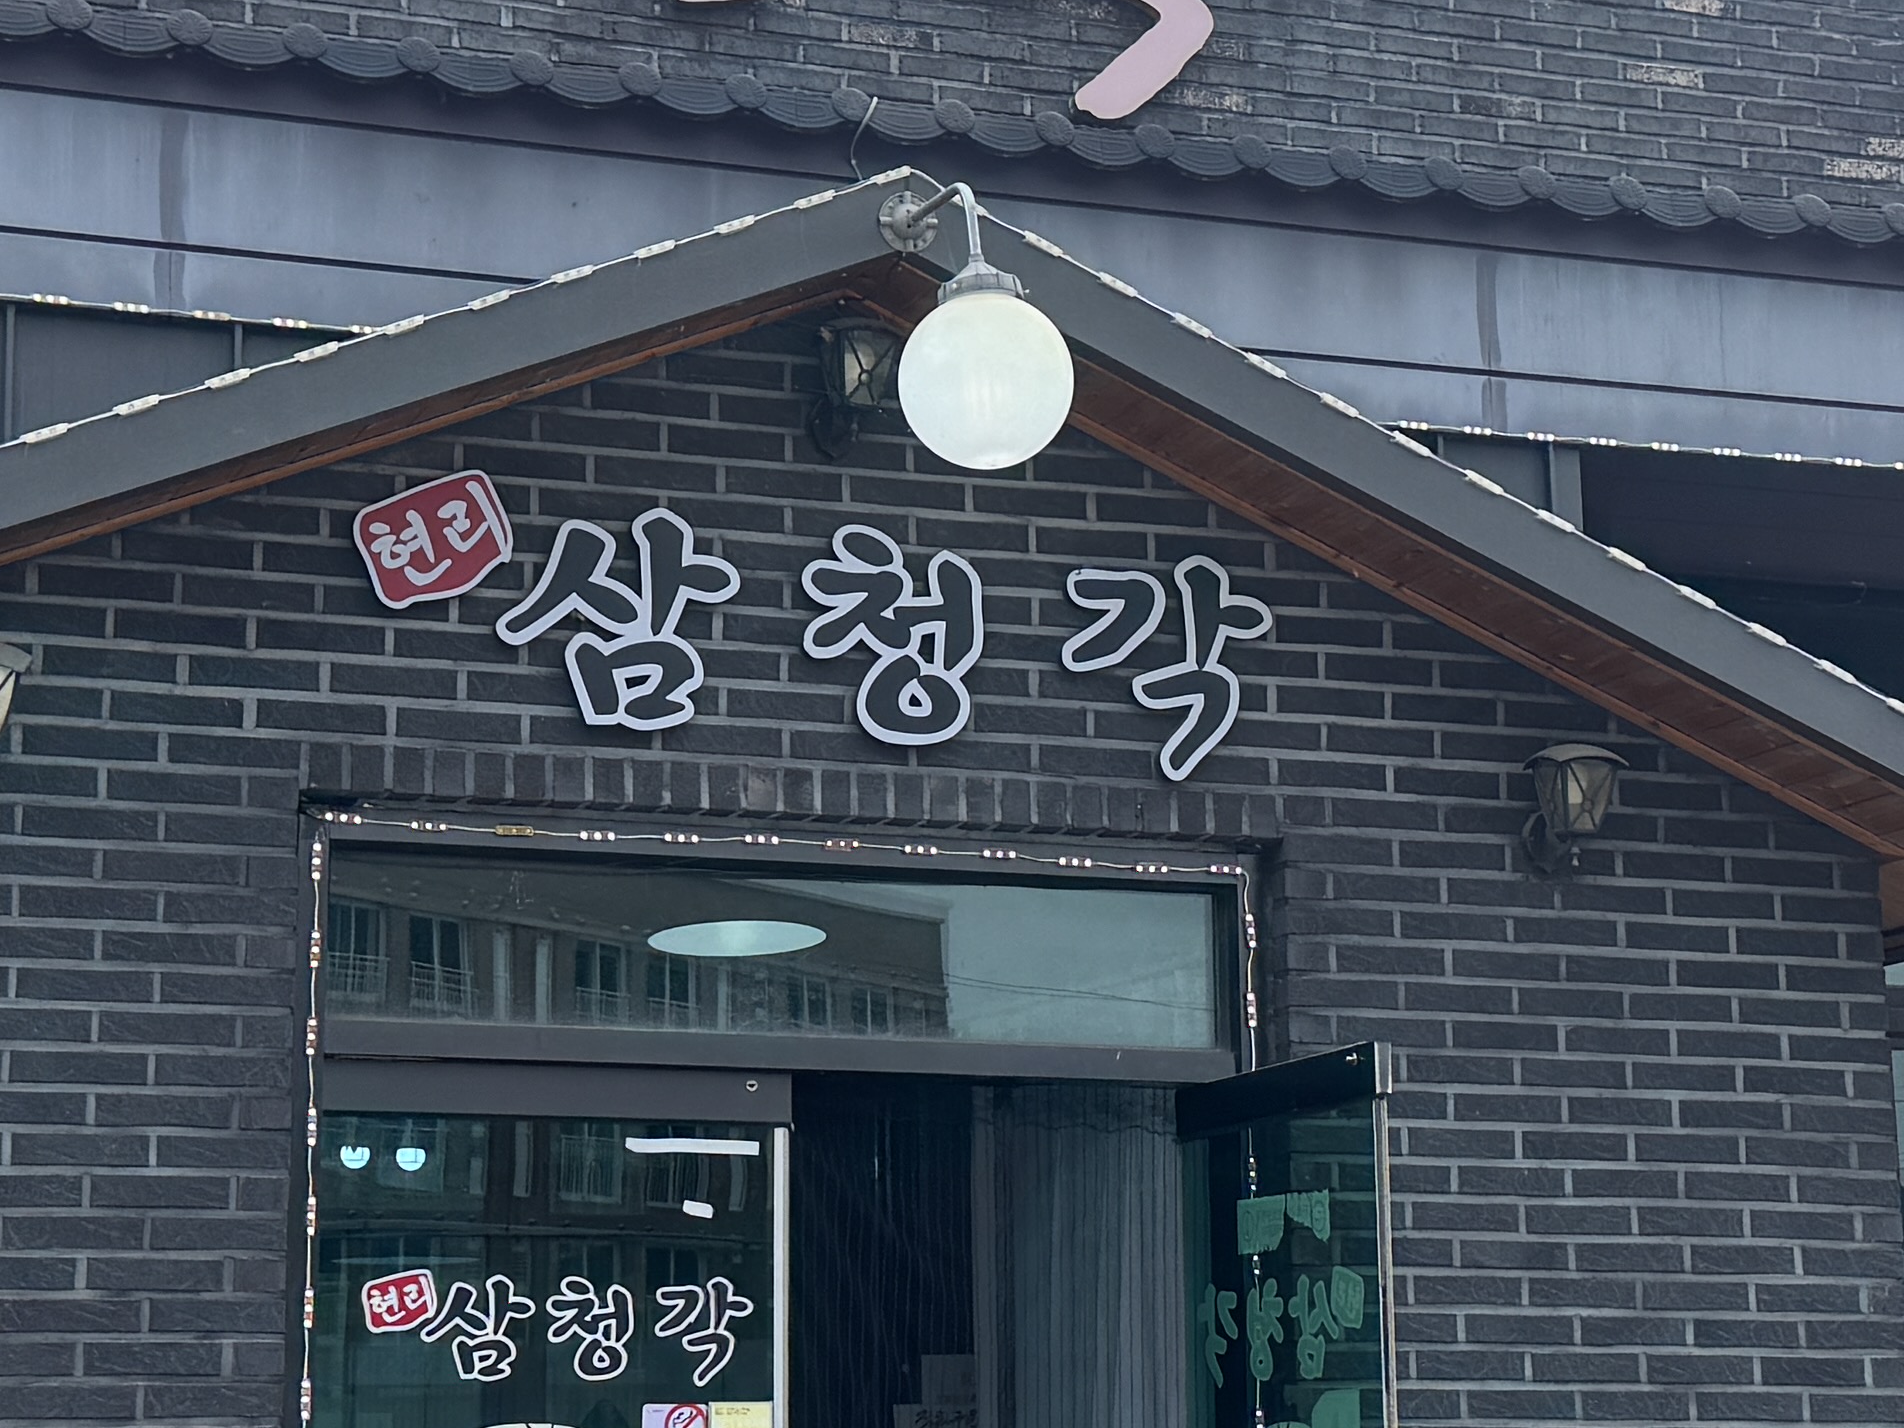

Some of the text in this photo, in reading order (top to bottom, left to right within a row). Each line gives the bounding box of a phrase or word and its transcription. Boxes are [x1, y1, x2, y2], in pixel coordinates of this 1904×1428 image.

[368, 472, 1273, 782] 현리 삼청각
[369, 1275, 754, 1387] 현리 삼청각
